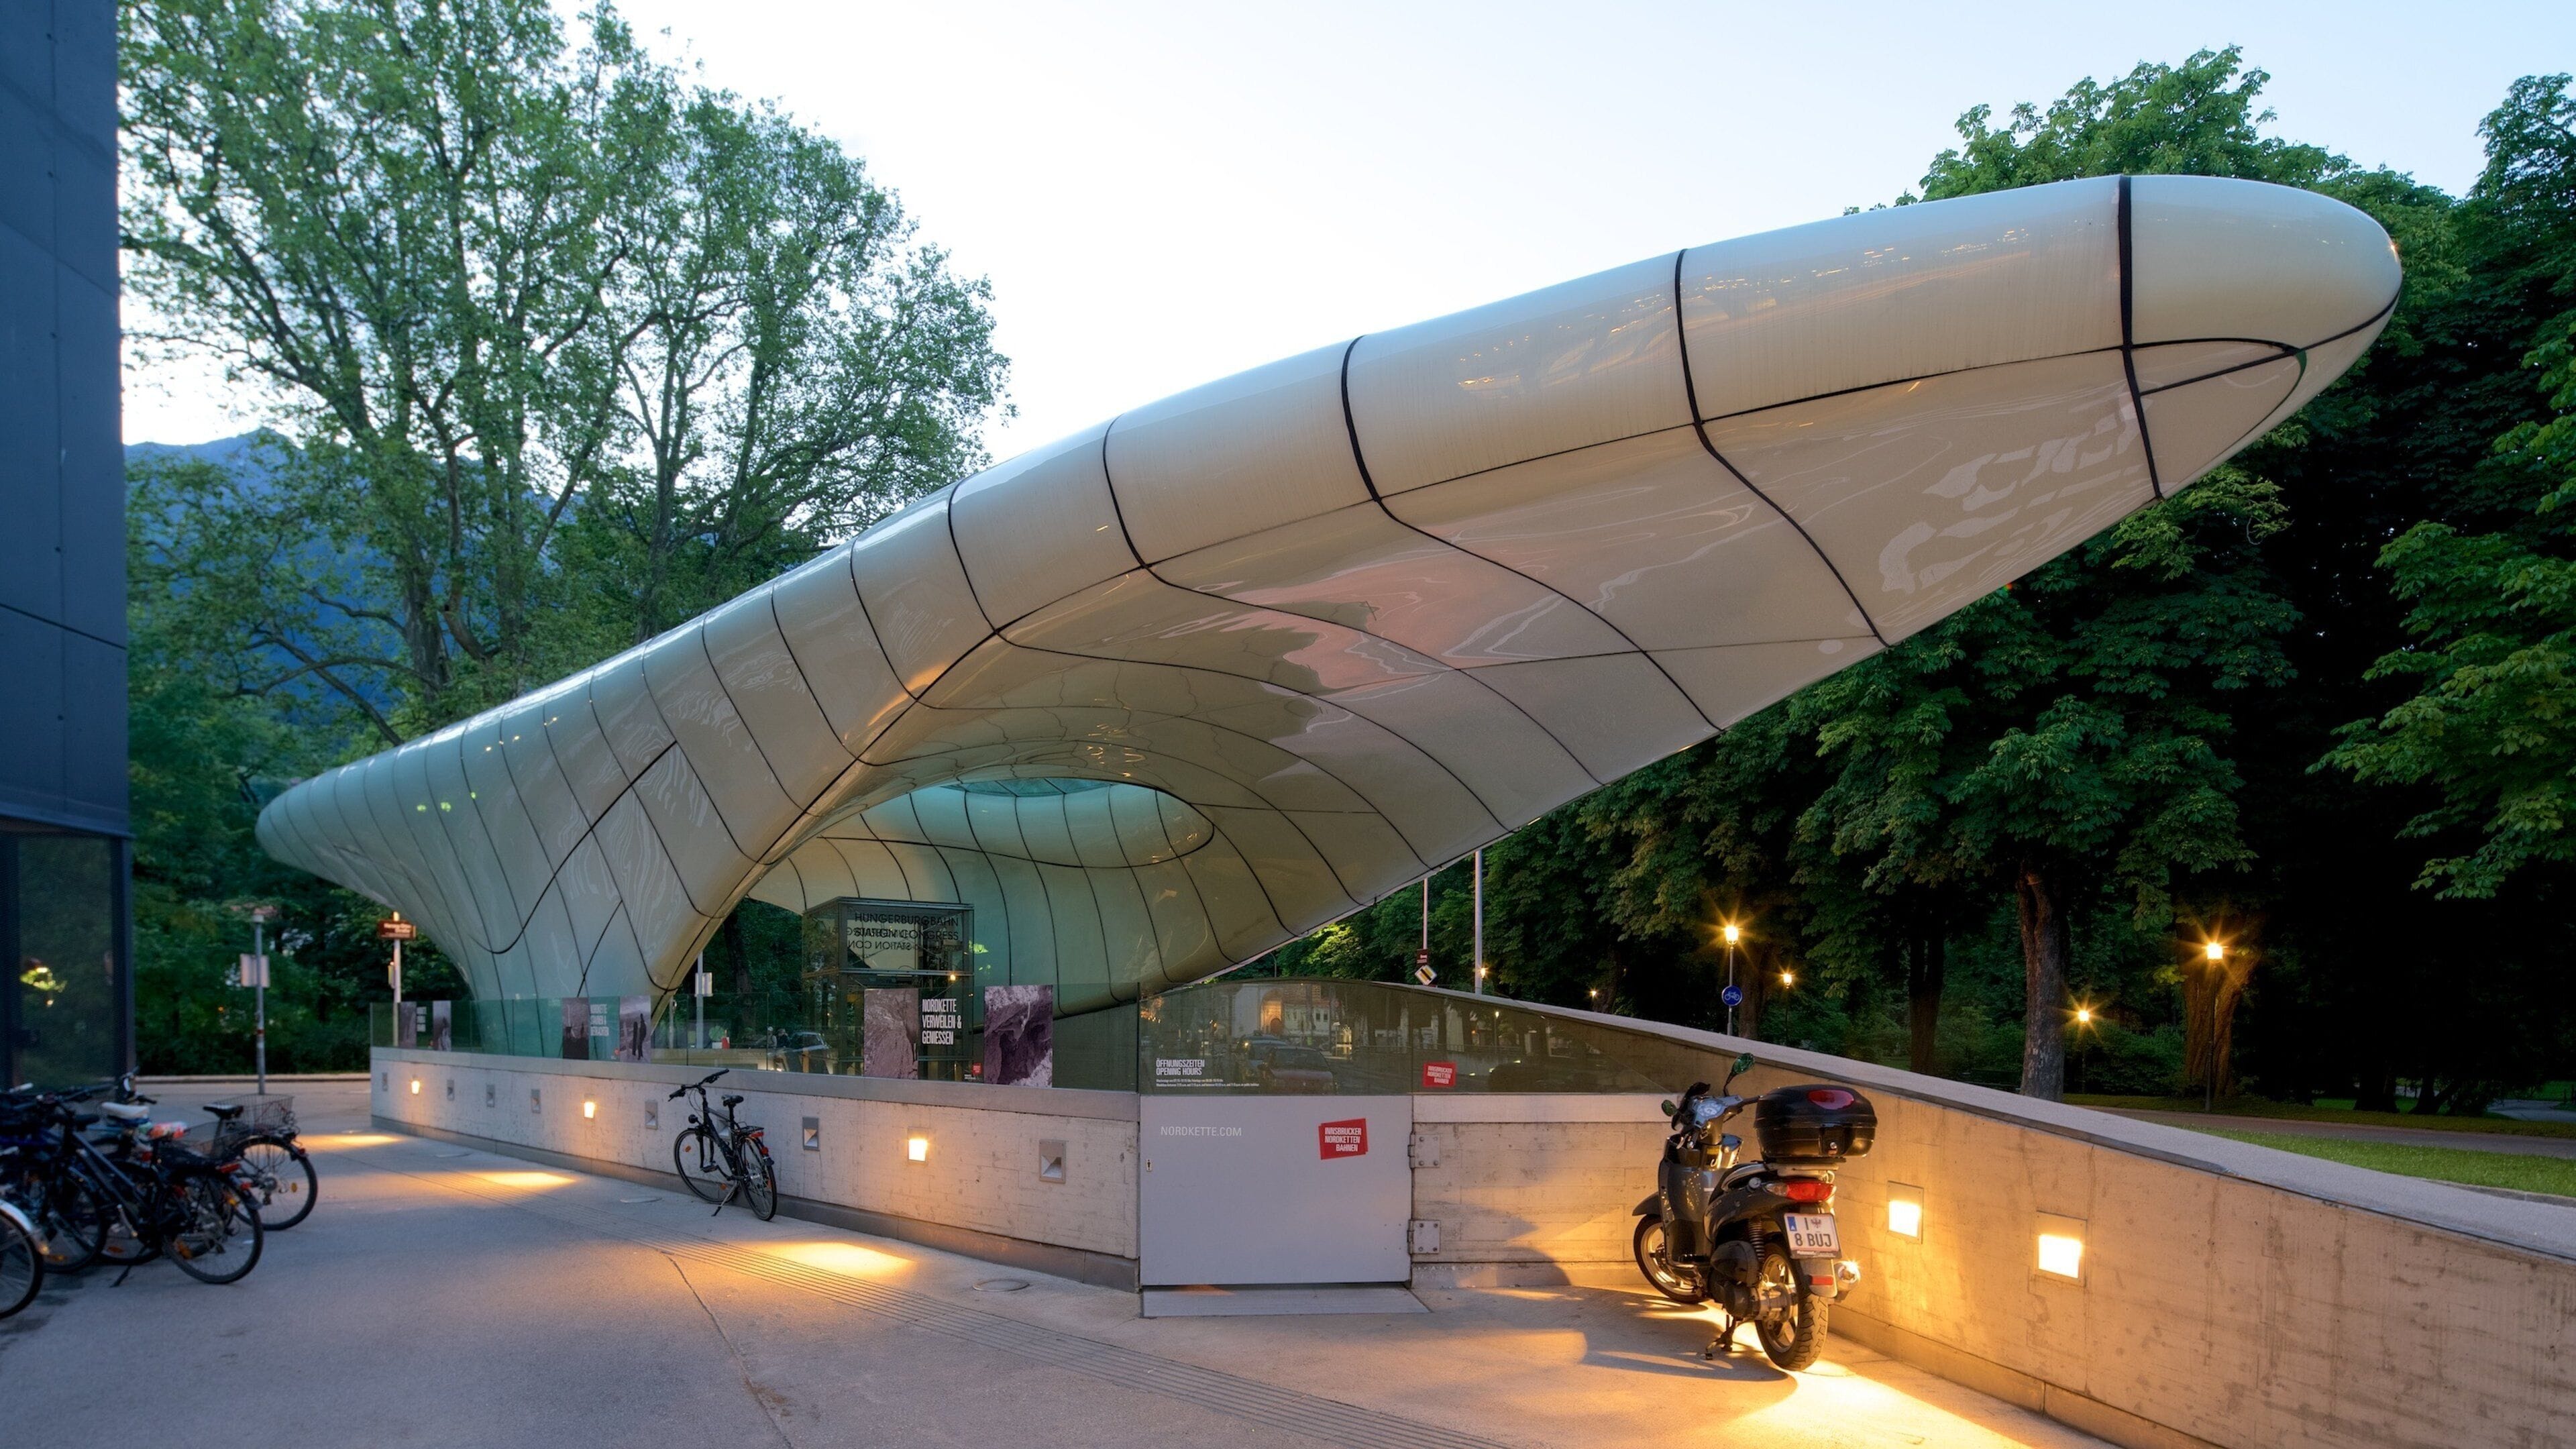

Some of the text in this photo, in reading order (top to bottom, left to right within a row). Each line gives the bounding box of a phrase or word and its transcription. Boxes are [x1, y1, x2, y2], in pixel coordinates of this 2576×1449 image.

[855, 912, 959, 926] HUNGERBURGBAHN
[900, 928, 959, 941] CONGRESS
[922, 999, 957, 1012] NORDKETTE
[922, 1015, 962, 1029] VERWEILEN &
[922, 1030, 954, 1044] GENIESSEN
[1156, 1057, 1205, 1067] ÖFFNUNGSZEITEN
[1156, 1067, 1181, 1075] OPENING
[1160, 1126, 1242, 1136] NORDKETTE.COM
[1324, 1127, 1362, 1135] INNSBRUCKER
[1324, 1135, 1360, 1143] NORDKETTEN
[1336, 1144, 1358, 1152] BAHNEN
[1804, 1217, 1809, 1230] I
[1794, 1232, 1832, 1247] 8 BUJ
